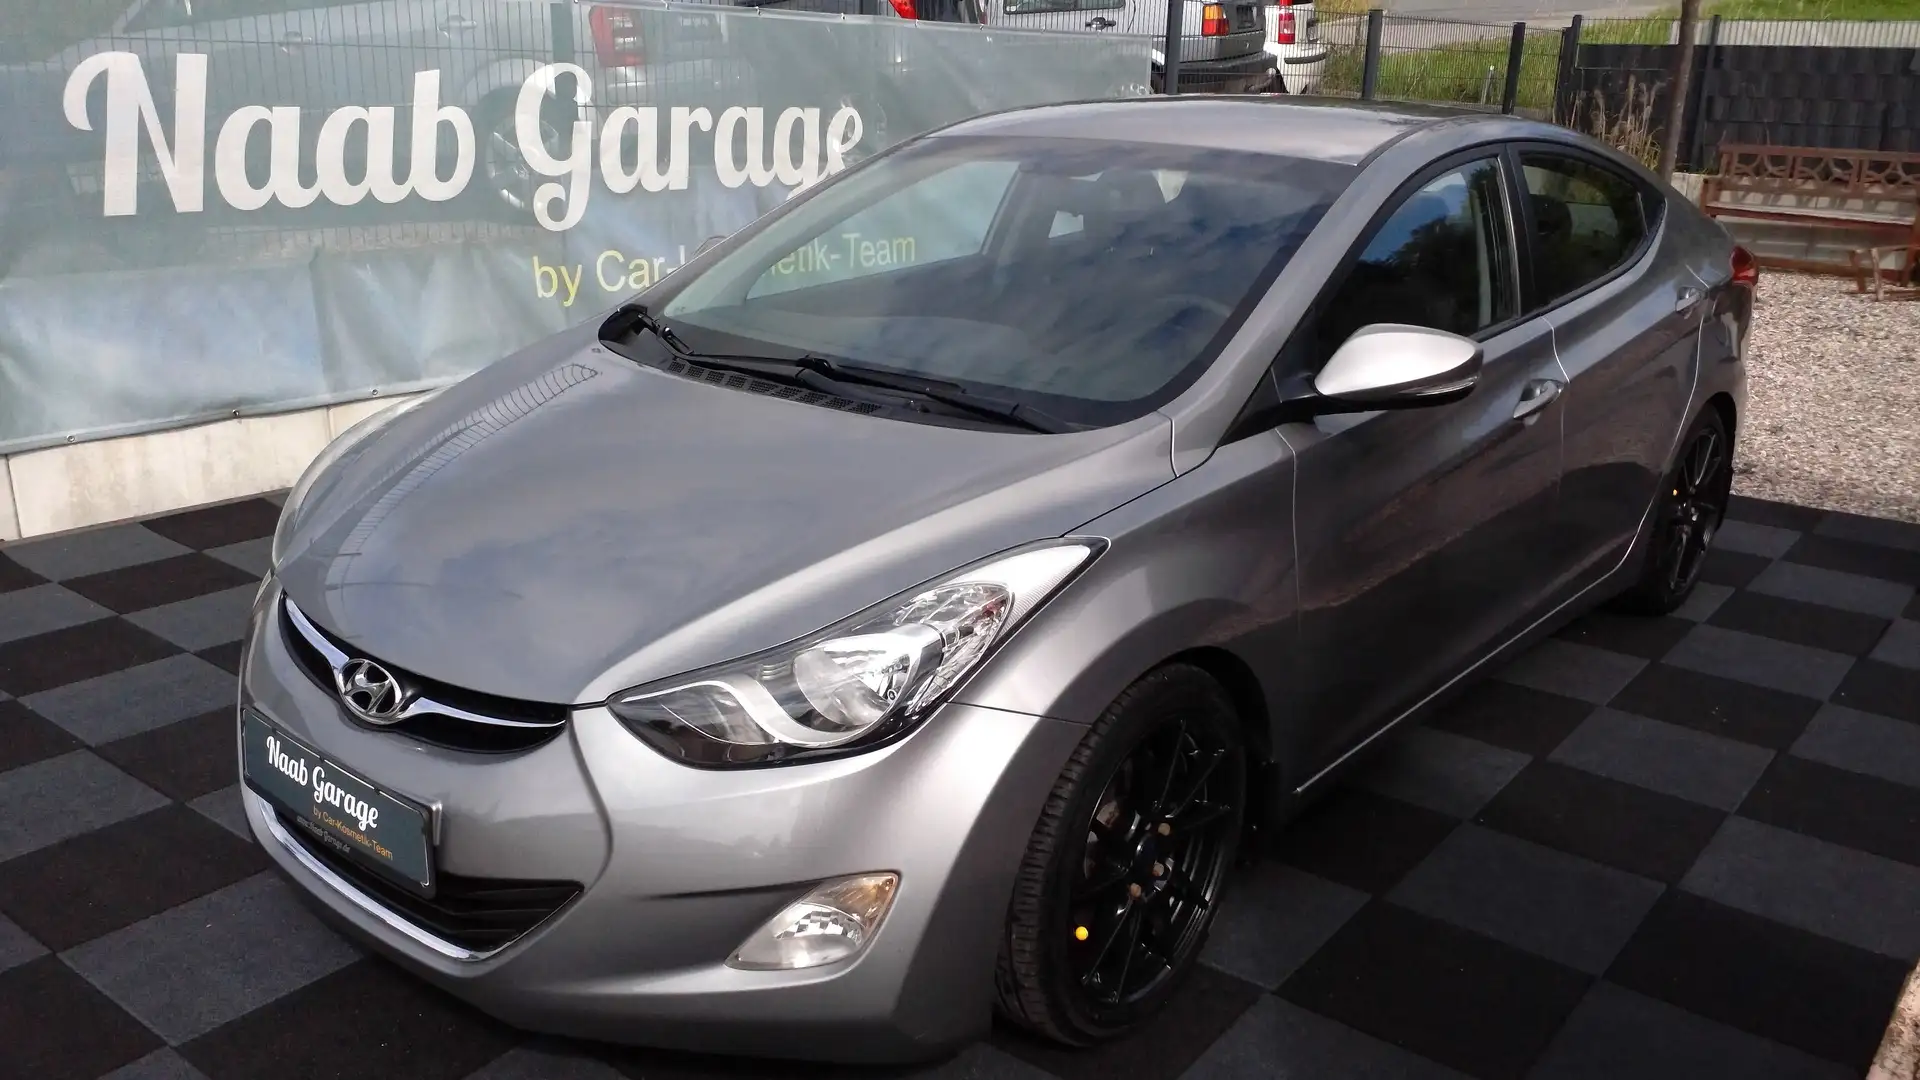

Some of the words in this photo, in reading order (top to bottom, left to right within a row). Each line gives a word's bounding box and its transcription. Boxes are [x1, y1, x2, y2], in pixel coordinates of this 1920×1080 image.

[62, 51, 476, 216] Naab
[515, 62, 864, 231] Garage
[532, 255, 583, 308] by
[266, 735, 308, 787] Naab
[312, 765, 379, 832] Garage
[312, 804, 323, 820] by
[323, 811, 394, 862] Car-Kosmetik-Team
